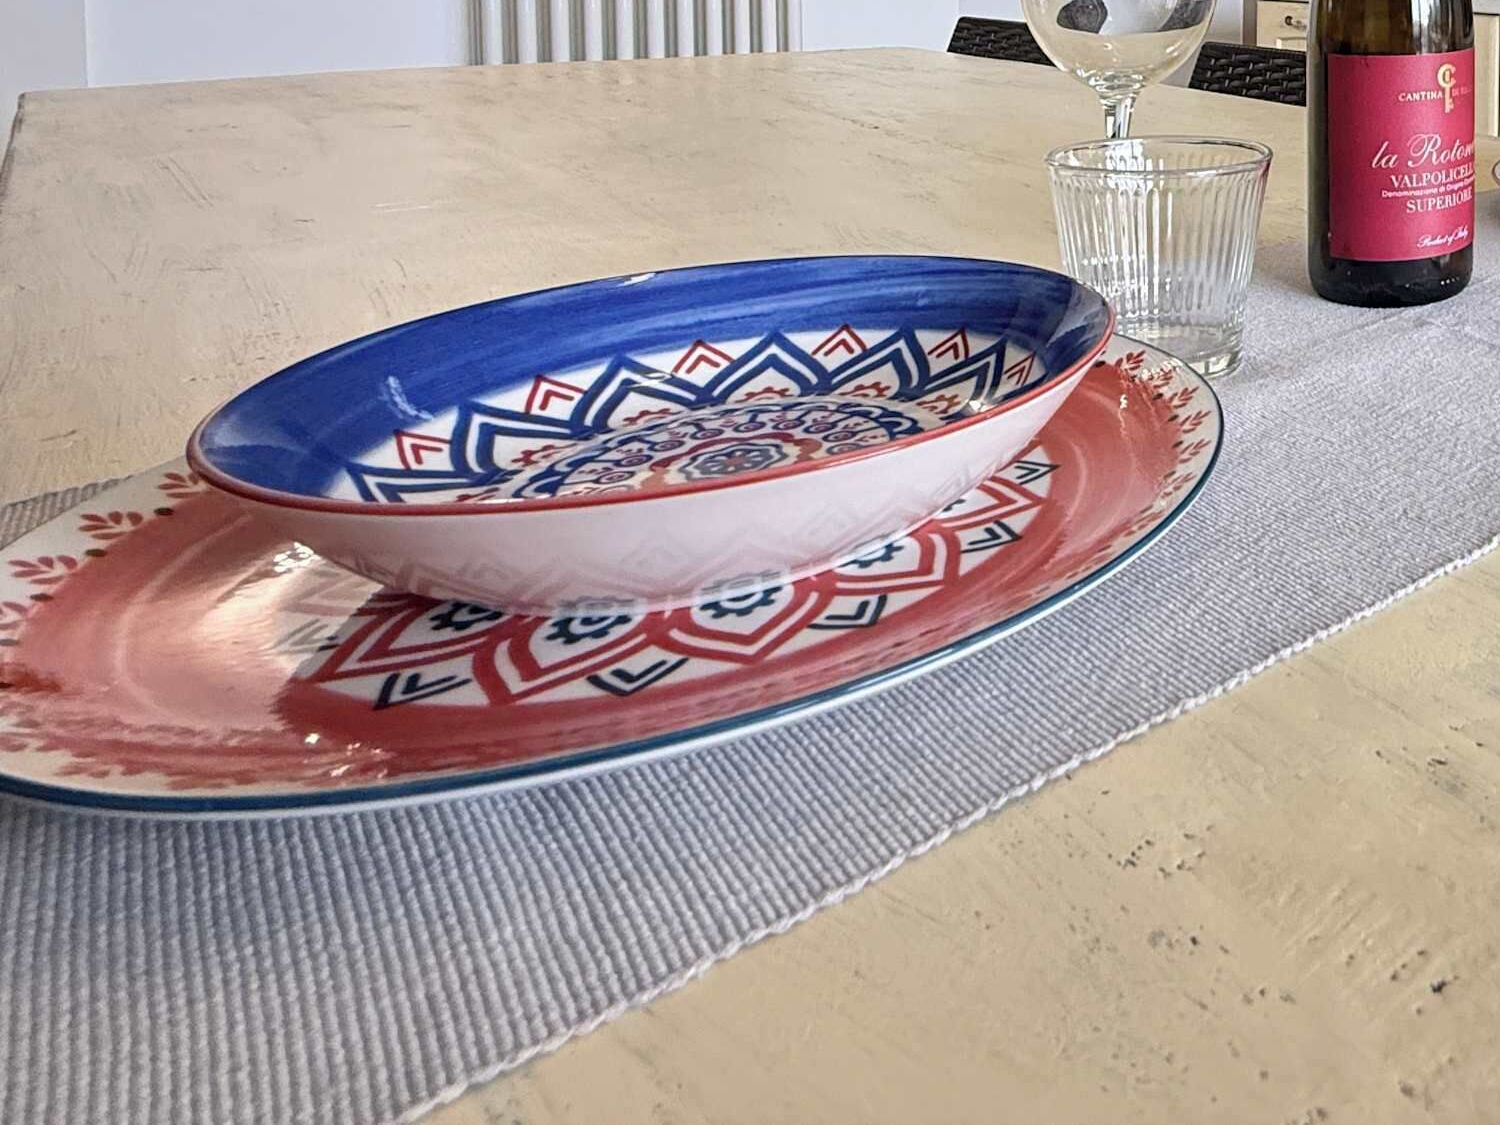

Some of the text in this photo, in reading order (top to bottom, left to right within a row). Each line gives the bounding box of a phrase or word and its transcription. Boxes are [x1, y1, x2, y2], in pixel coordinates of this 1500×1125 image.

[1398, 90, 1442, 101] CANTINA
[1371, 141, 1398, 169] la
[1382, 188, 1438, 198] Denominazione
[1406, 186, 1473, 213] SUPERIORE
